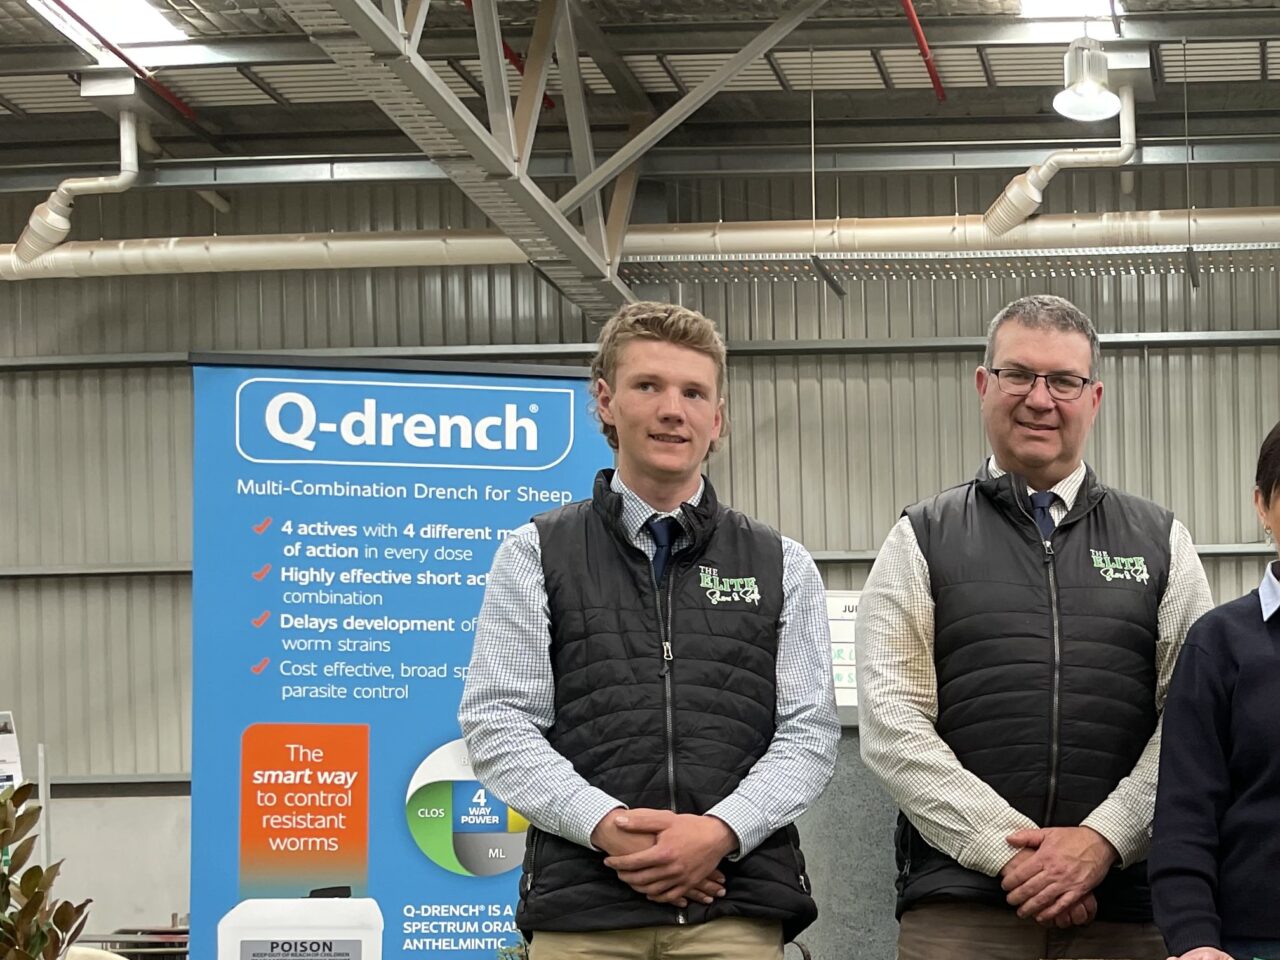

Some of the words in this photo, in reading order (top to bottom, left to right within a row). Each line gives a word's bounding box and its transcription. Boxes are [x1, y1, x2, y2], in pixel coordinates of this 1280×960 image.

[236, 478, 407, 498] Multi-Combination
[414, 483, 478, 500] Drench
[485, 485, 511, 501] for
[517, 486, 573, 506] Sheep
[281, 519, 293, 535] 4
[297, 520, 358, 537] actives
[363, 523, 398, 538] with
[403, 523, 415, 538] 4
[420, 524, 492, 540] different
[283, 542, 302, 557] of
[306, 543, 358, 558] action
[364, 544, 378, 559] in
[384, 547, 428, 563] every
[434, 546, 473, 561] dose
[699, 565, 718, 576] THE
[1092, 555, 1145, 570] ELITE
[281, 567, 335, 586] Highly
[340, 568, 412, 585] effective
[417, 570, 462, 585] short
[700, 573, 757, 592] ELITE
[283, 589, 383, 606] combination
[280, 613, 338, 633] Delays
[342, 615, 455, 634] development
[460, 617, 479, 632] of
[281, 639, 332, 651] worm
[338, 637, 391, 652] strains
[280, 660, 318, 676] Cost
[323, 661, 394, 680] effective,
[400, 663, 447, 678] broad
[282, 683, 347, 701] parasite
[353, 684, 409, 699] control
[285, 744, 324, 762] The
[252, 768, 313, 784] smart
[317, 771, 358, 789] way
[257, 790, 277, 806] to
[284, 789, 352, 807] control
[472, 788, 487, 806] 4
[417, 808, 445, 818] CLOS
[461, 815, 500, 824] POWER
[468, 807, 492, 815] WAY
[262, 811, 347, 829] resistant
[268, 837, 339, 851] worms
[488, 848, 506, 858] ML
[488, 904, 500, 917] IS
[503, 904, 514, 917] A
[403, 921, 479, 933] SPECTRUM
[270, 941, 333, 952] POISON
[402, 938, 507, 951] ANTHELMINTIC
